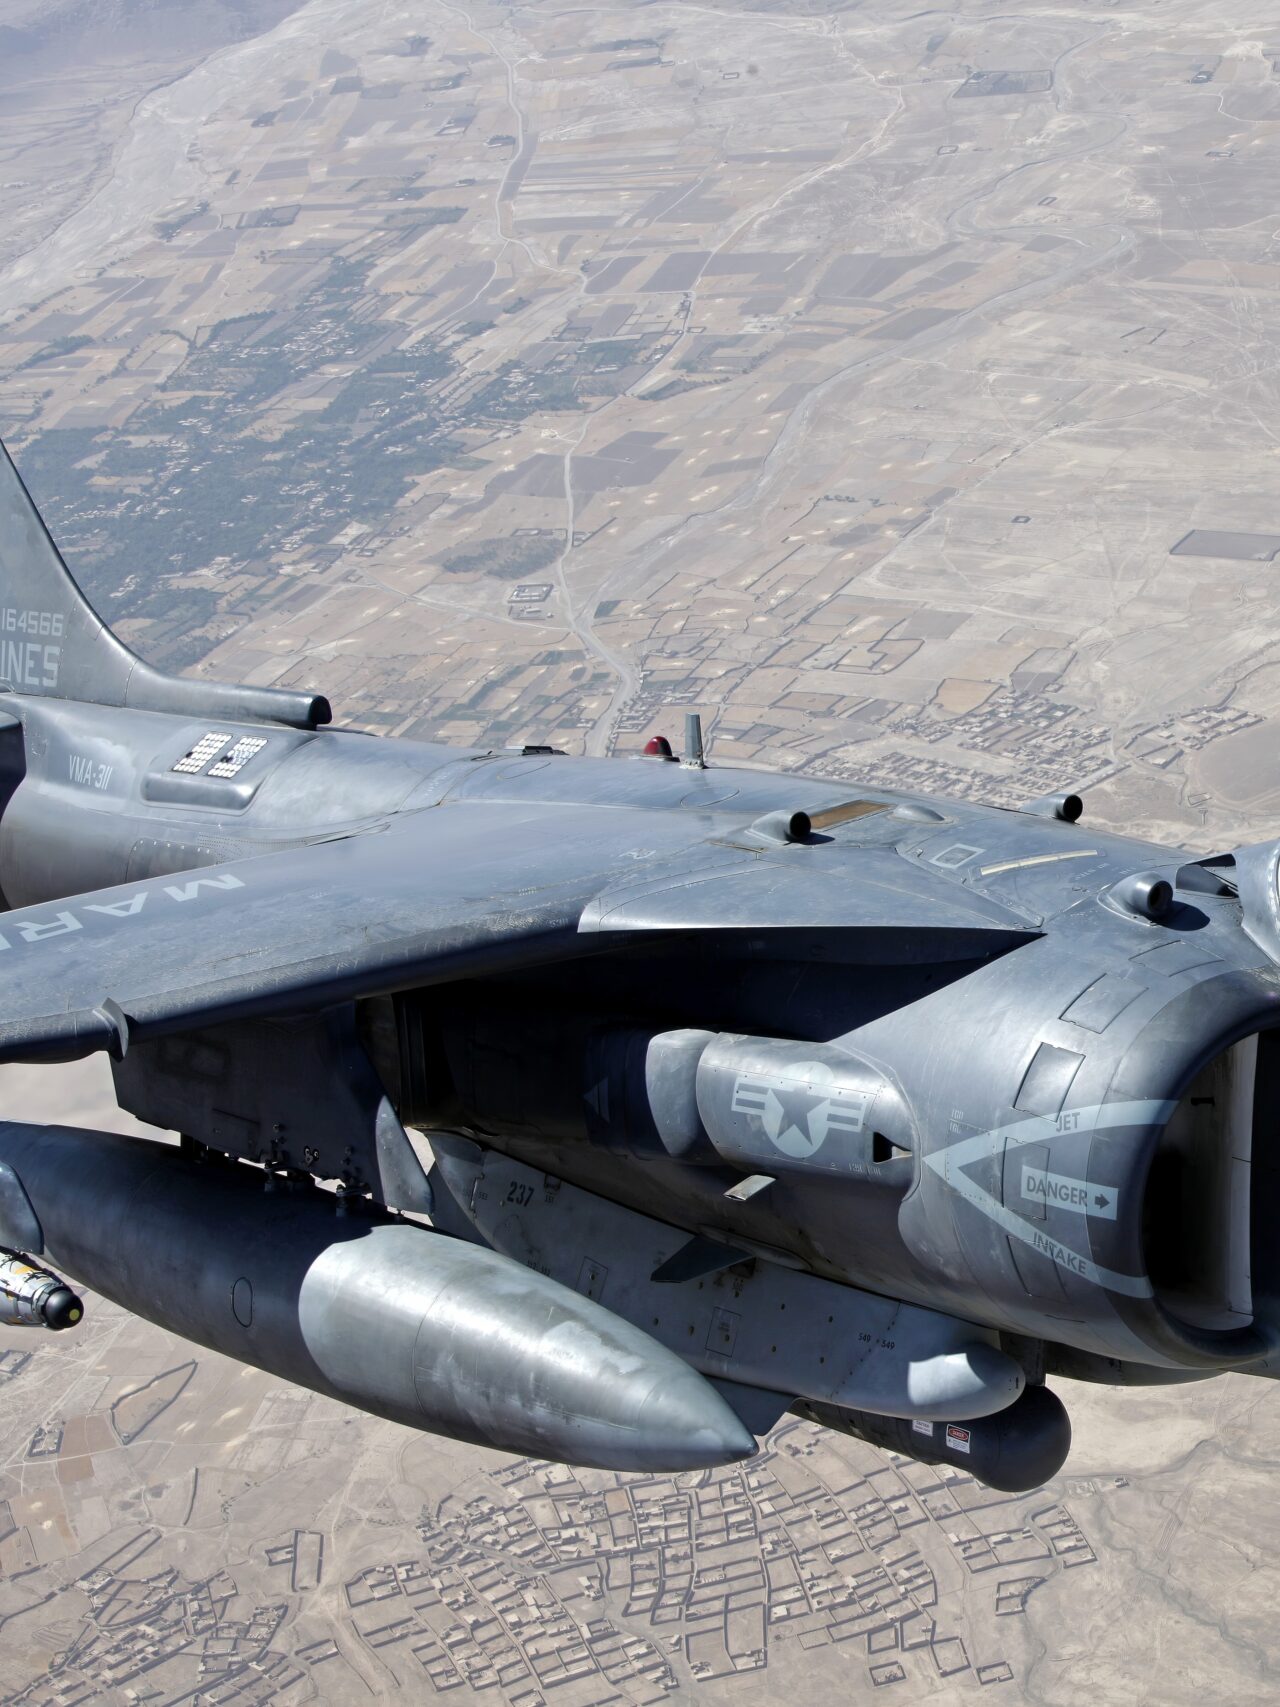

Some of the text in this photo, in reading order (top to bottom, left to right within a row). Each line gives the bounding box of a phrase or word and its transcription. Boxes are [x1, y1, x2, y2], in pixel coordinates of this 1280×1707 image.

[1, 608, 64, 637] 164566
[1056, 1112, 1081, 1133] JET
[506, 1180, 535, 1207] 237
[1026, 1175, 1088, 1207] DANGER
[1033, 1231, 1087, 1274] INTAKE
